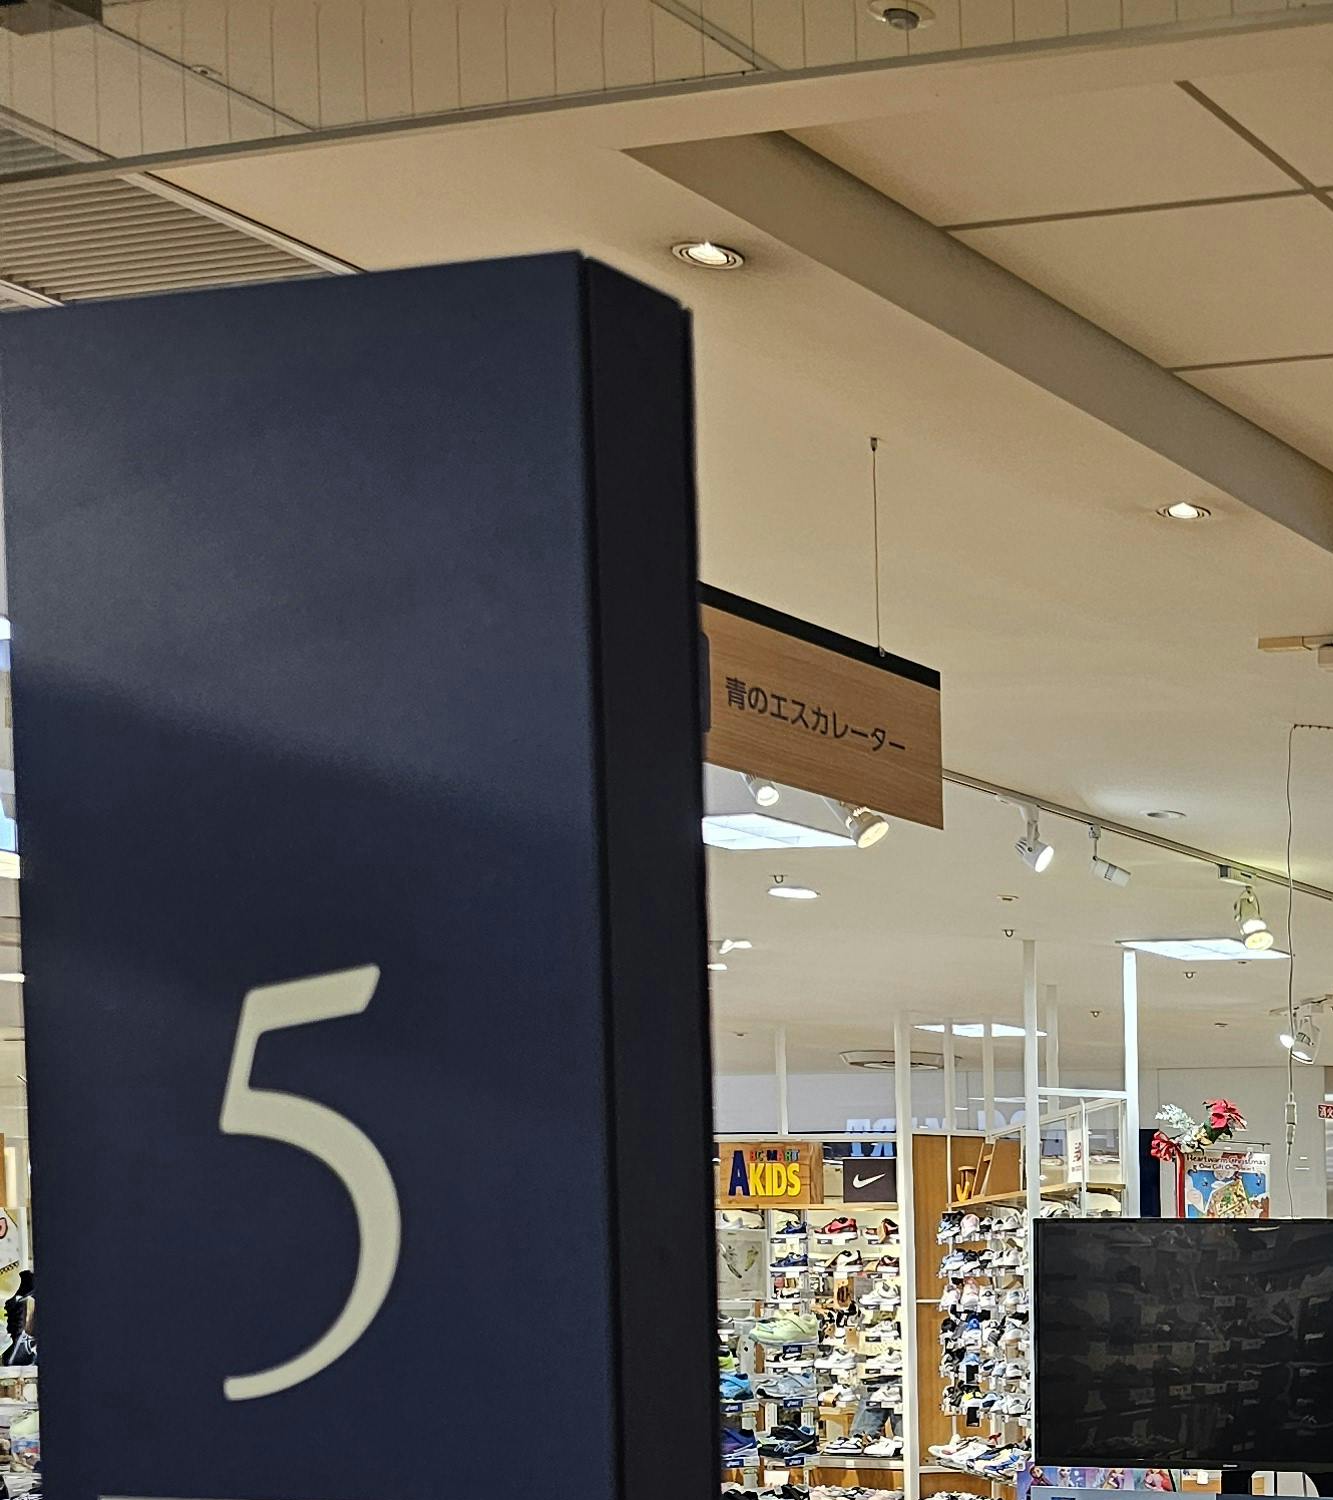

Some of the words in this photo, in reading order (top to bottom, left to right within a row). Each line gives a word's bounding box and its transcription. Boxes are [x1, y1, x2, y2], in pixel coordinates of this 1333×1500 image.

[725, 676, 906, 752] 青のエスカレーター
[219, 963, 400, 1401] 5
